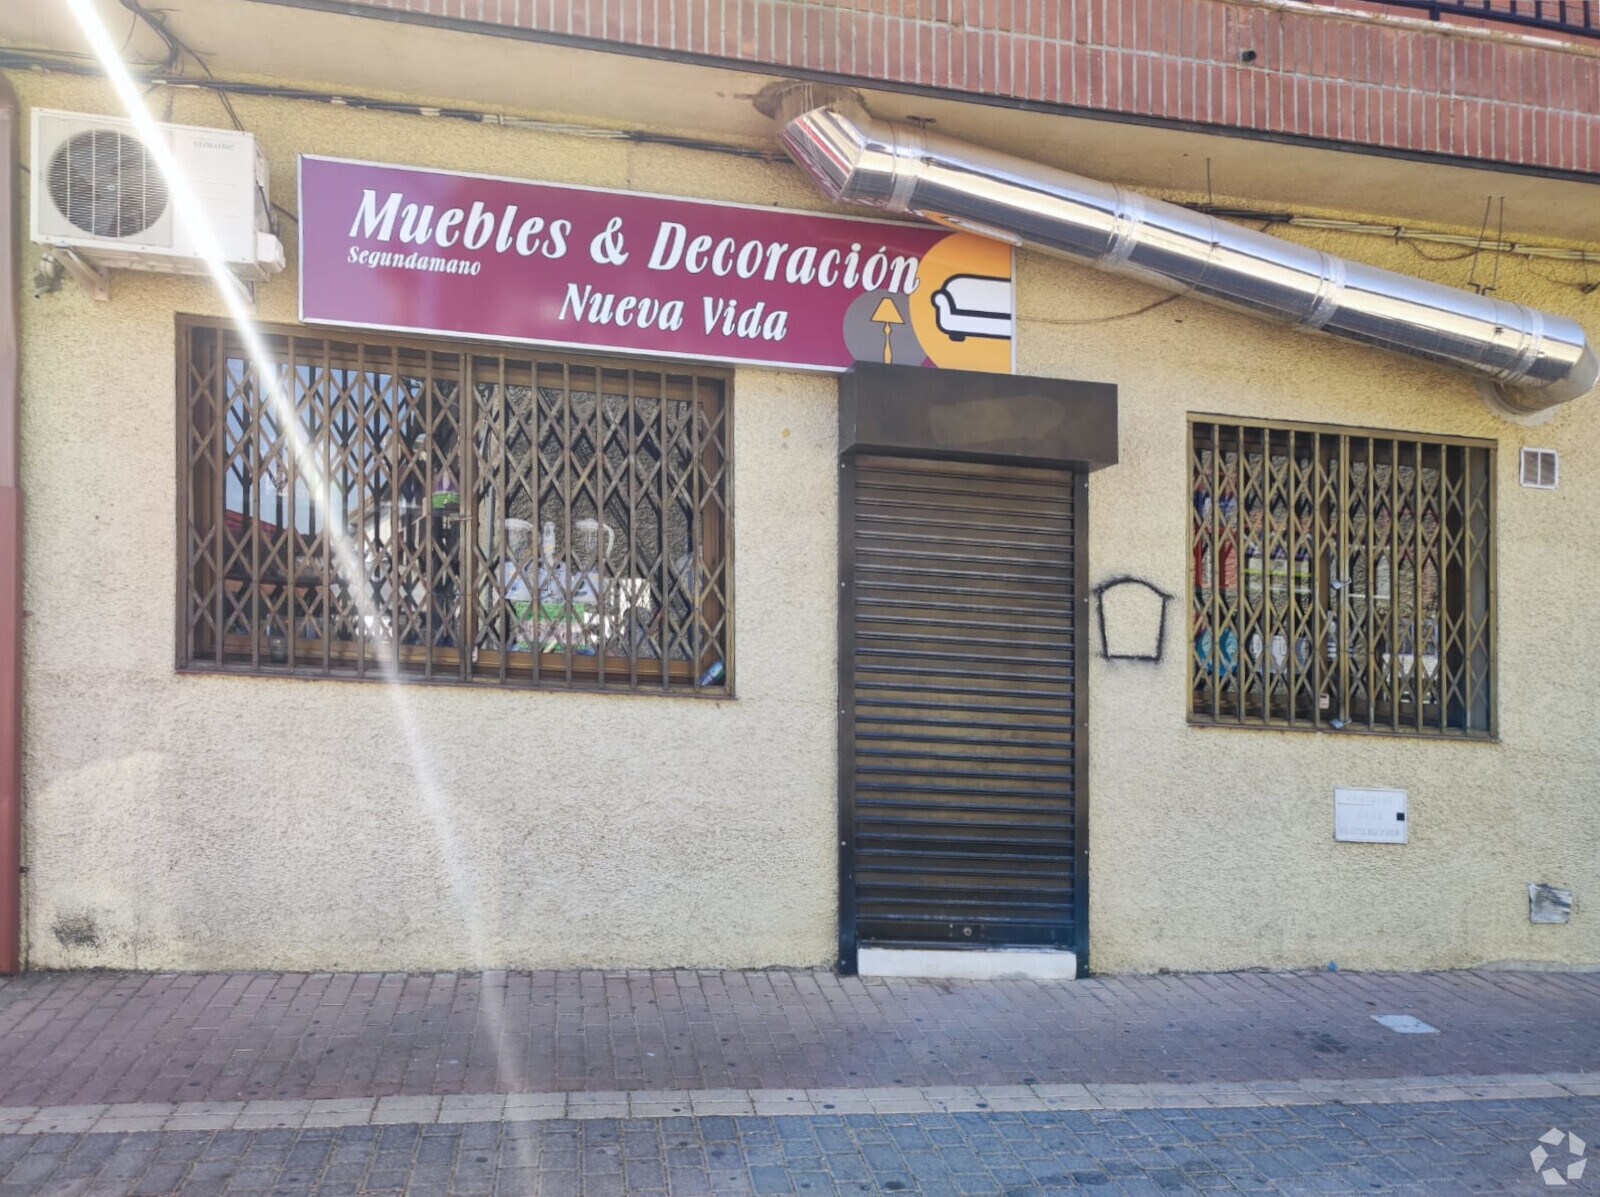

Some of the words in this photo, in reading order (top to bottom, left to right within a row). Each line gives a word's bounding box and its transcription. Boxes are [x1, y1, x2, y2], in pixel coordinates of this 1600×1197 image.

[347, 246, 481, 276] Segundamano
[349, 189, 572, 259] Muebles
[590, 216, 629, 266] &
[648, 221, 920, 295] Decoración
[558, 283, 685, 332] Nueva
[703, 296, 788, 341] Vida
